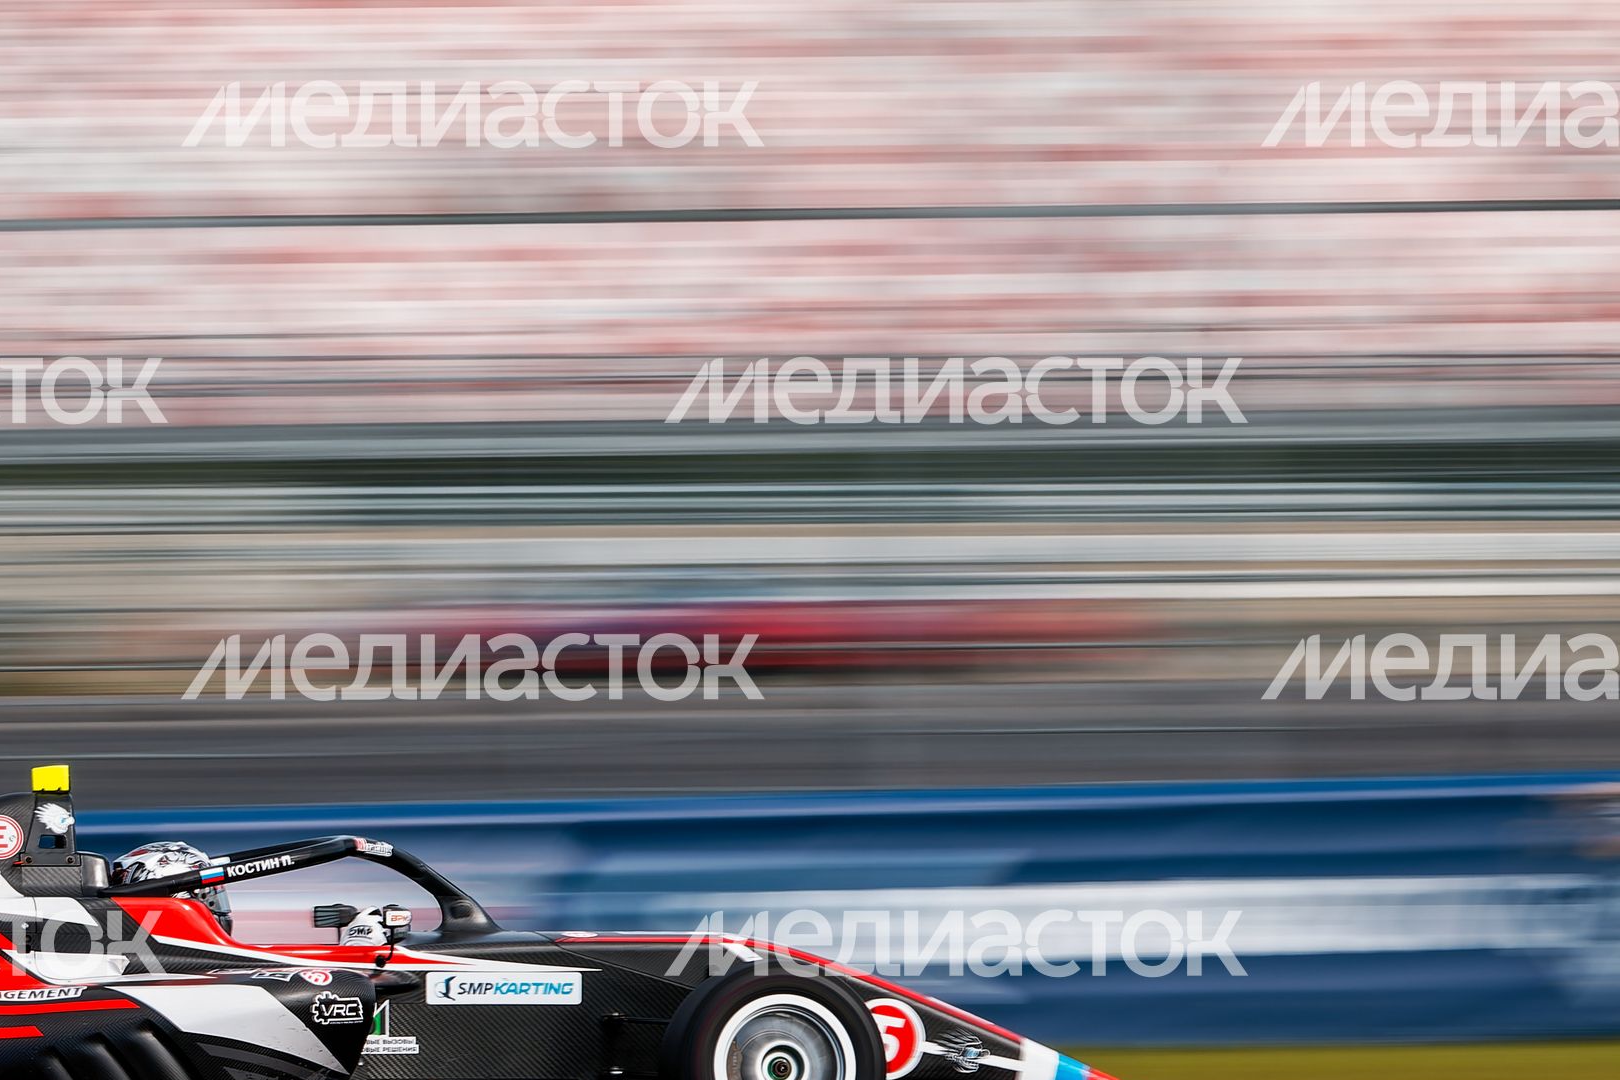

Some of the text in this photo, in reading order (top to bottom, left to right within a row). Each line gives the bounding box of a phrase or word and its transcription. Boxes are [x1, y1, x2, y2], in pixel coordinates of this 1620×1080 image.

[227, 855, 295, 877] КОСТИН П.
[320, 1003, 358, 1017] VRC
